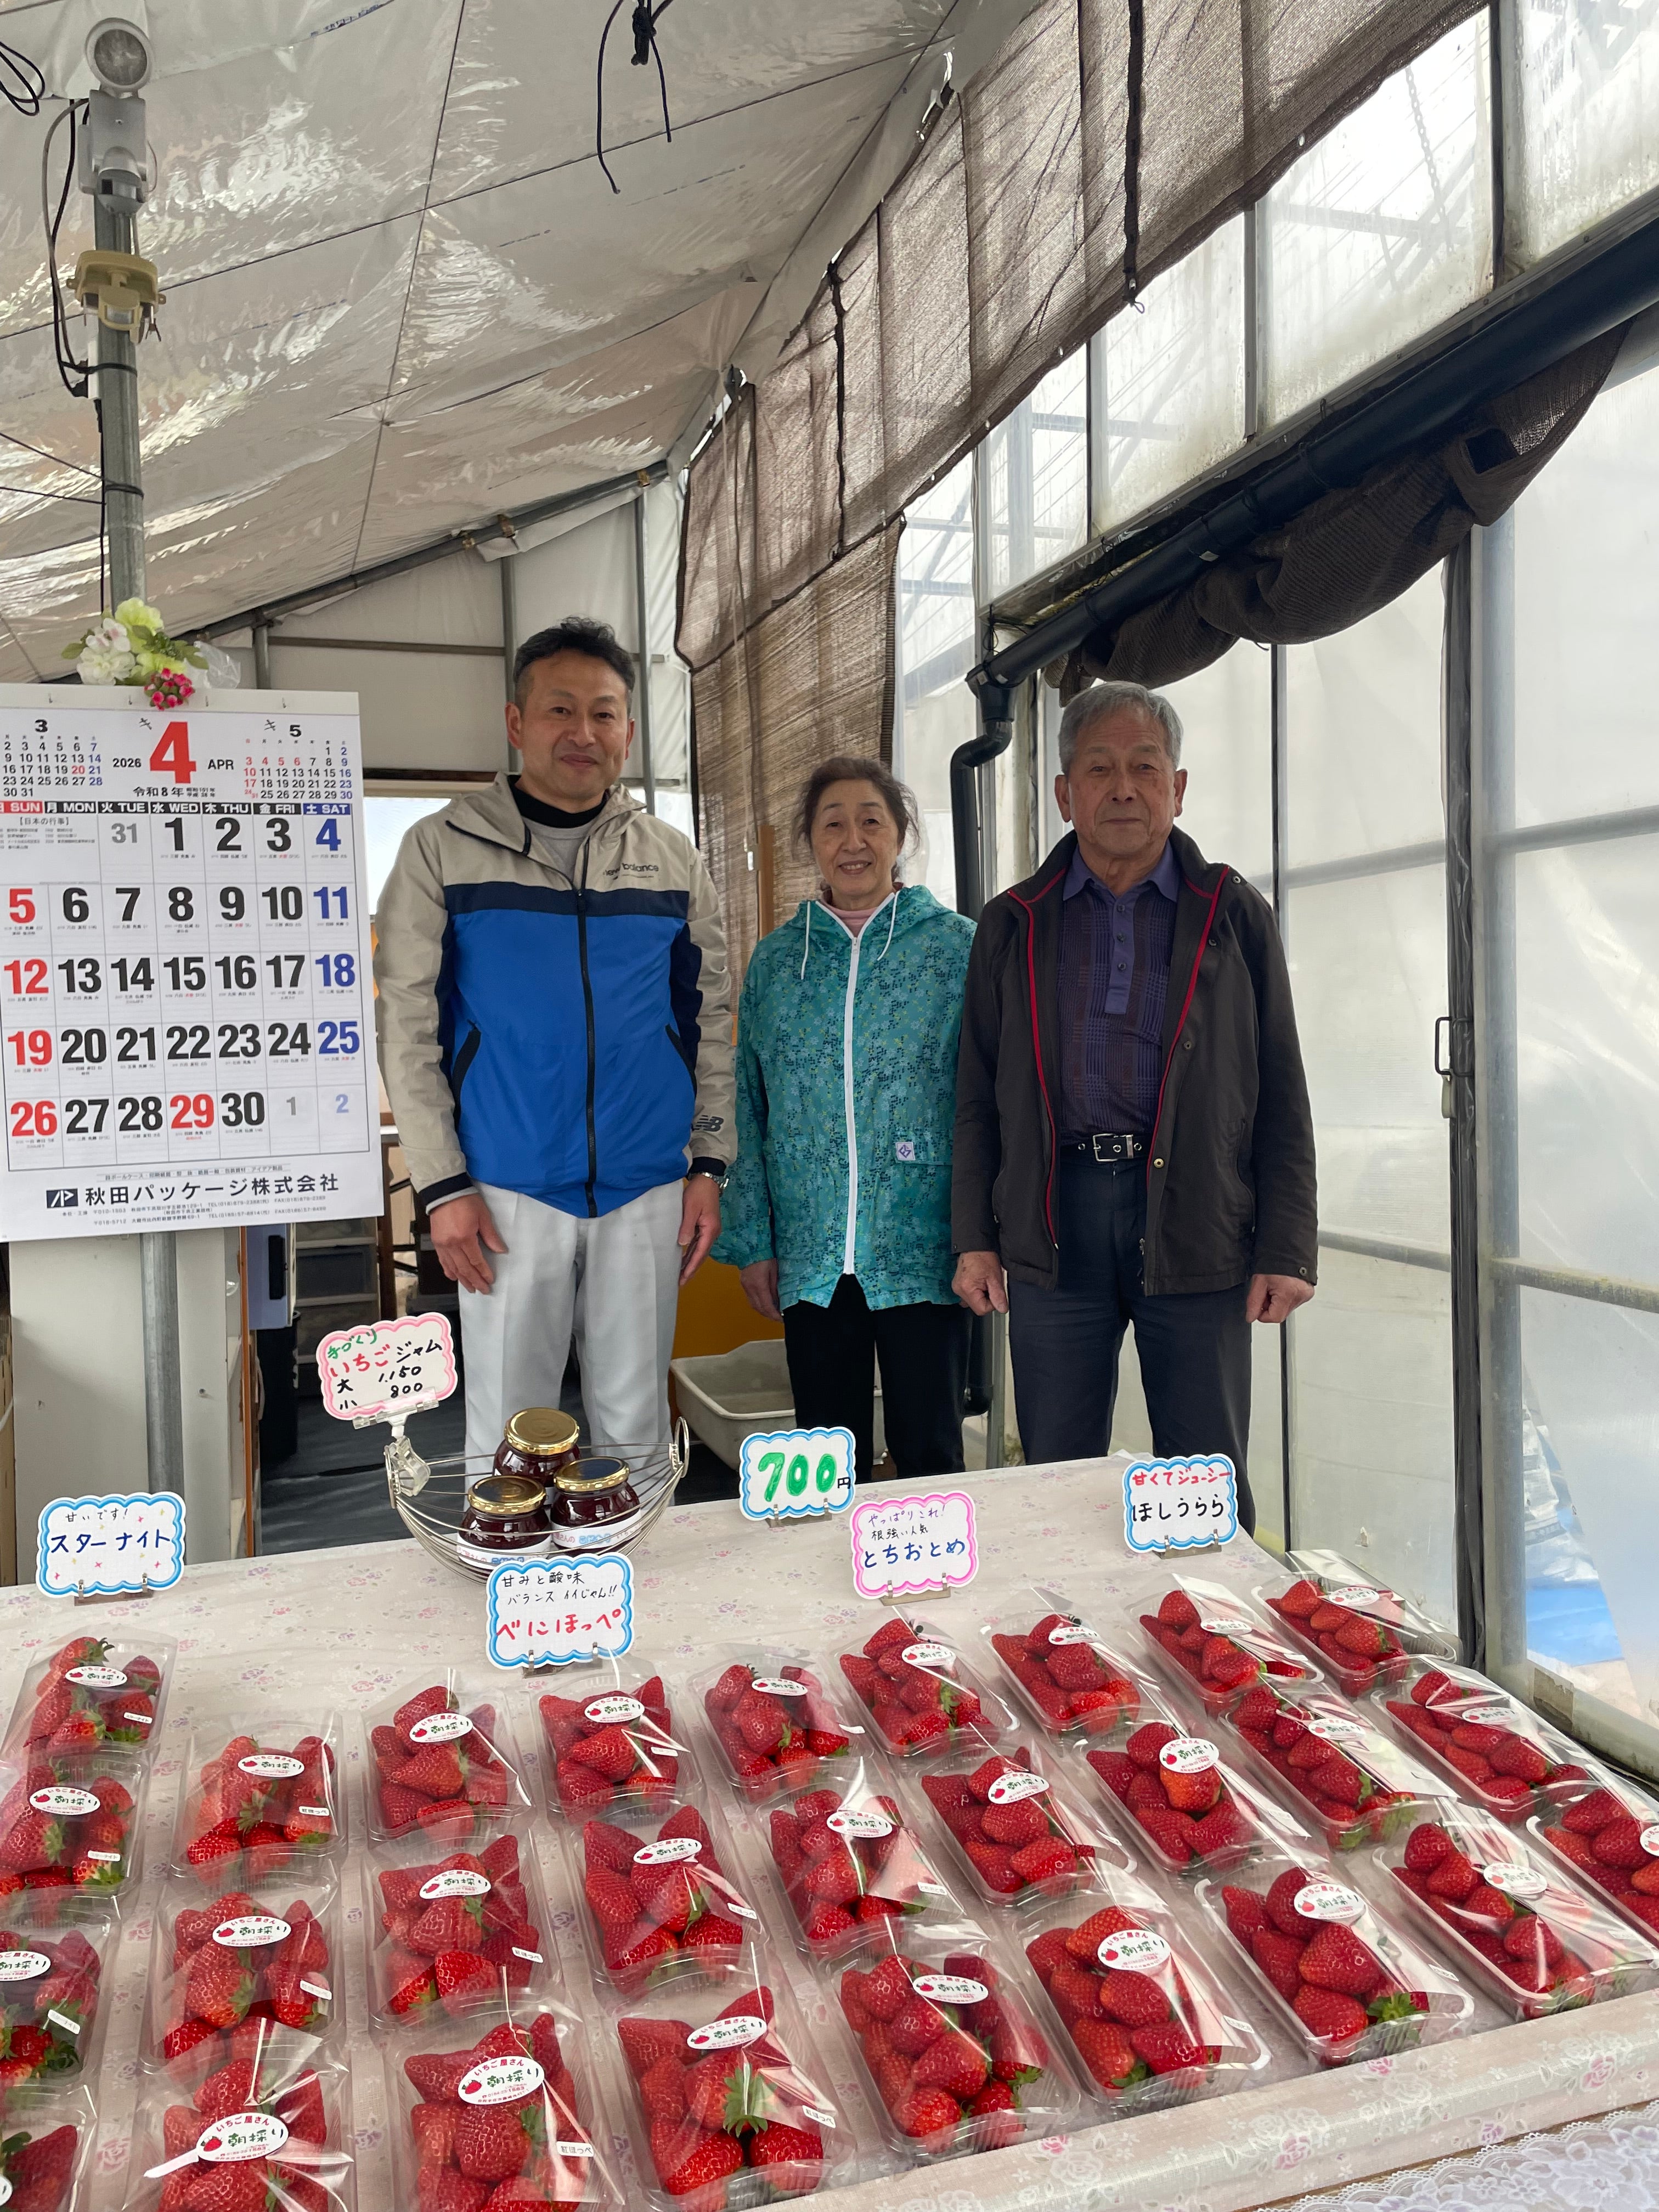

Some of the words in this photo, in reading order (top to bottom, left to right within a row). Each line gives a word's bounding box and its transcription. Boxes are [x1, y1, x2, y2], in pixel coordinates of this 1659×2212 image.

[35, 720, 48, 732] 3
[290, 725, 301, 737] 5
[149, 721, 196, 783] 4
[3, 765, 16, 774] 16
[21, 765, 33, 774] 17
[38, 765, 50, 774] 18
[55, 765, 67, 774] 19
[72, 765, 84, 774] 20
[89, 766, 100, 774] 21
[113, 758, 141, 767] 2026
[208, 759, 233, 770] APR
[3, 776, 16, 785] 23
[38, 776, 51, 785] 25
[55, 777, 68, 785] 26
[72, 777, 85, 785] 27
[89, 777, 102, 786] 28
[260, 768, 270, 776] 11
[292, 769, 303, 777] 13
[133, 787, 184, 797] 令和8年
[245, 779, 256, 787] 17
[292, 780, 304, 788] 20
[308, 780, 319, 788] 21
[11, 802, 40, 812] SUN
[47, 803, 57, 813] 月
[64, 803, 94, 812] MON
[101, 803, 114, 813] 火
[117, 803, 145, 812] TUE
[152, 803, 165, 813] 水
[169, 803, 198, 813] WED
[205, 804, 217, 814] 木
[221, 804, 249, 814] THU
[259, 804, 270, 814] 金
[275, 804, 295, 814] FRI
[306, 805, 317, 814] 土
[322, 804, 348, 814] SAT
[111, 823, 137, 843] 31
[165, 817, 183, 851] 1
[216, 817, 241, 851] 2
[267, 818, 291, 851] 3
[316, 819, 341, 851] 4
[622, 862, 659, 872] balance
[10, 889, 35, 923] 5
[63, 888, 89, 922] 6
[116, 888, 140, 921] 7
[168, 887, 193, 921] 8
[220, 887, 245, 921] 9
[262, 887, 302, 919] 10
[314, 887, 348, 919] 11
[4, 959, 48, 994] 12
[58, 958, 101, 992] 13
[111, 958, 154, 991] 14
[163, 957, 206, 990] 15
[215, 956, 256, 989] 16
[266, 955, 304, 988] 17
[315, 953, 355, 986] 18
[8, 1030, 52, 1065] 19
[61, 1029, 106, 1063] 20
[116, 1027, 156, 1062] 21
[167, 1025, 211, 1059] 22
[218, 1024, 261, 1058] 23
[268, 1023, 311, 1056] 24
[318, 1022, 359, 1054] 25
[11, 1101, 57, 1136] 26
[65, 1099, 109, 1133] 27
[118, 1097, 162, 1131] 28
[170, 1094, 214, 1128] 29
[221, 1092, 264, 1126] 30
[286, 1097, 296, 1115] 1
[336, 1094, 348, 1113] 2
[85, 1173, 339, 1206] 秋田パッケージ株式会社
[337, 1379, 353, 1393] 大
[340, 1400, 357, 1410] 小
[391, 1383, 422, 1398] 800
[758, 1452, 837, 1502] 700
[837, 1477, 851, 1489] 円
[1132, 1466, 1231, 1486] 甘くてジューシー
[1133, 1494, 1224, 1521] ほしうらら
[51, 1529, 170, 1553] スターナイト
[872, 1523, 928, 1541] 根強い人気
[865, 1539, 965, 1568] とちおとめ
[501, 1571, 585, 1587] 甘みと酸味
[496, 1609, 621, 1640] べにほっぺ
[239, 1926, 287, 1936] 朝採り
[713, 2021, 763, 2039] 朝採り
[487, 2068, 539, 2087] 朝採り
[216, 2116, 269, 2132] いちご屋さん
[228, 2129, 284, 2147] 朝採り
